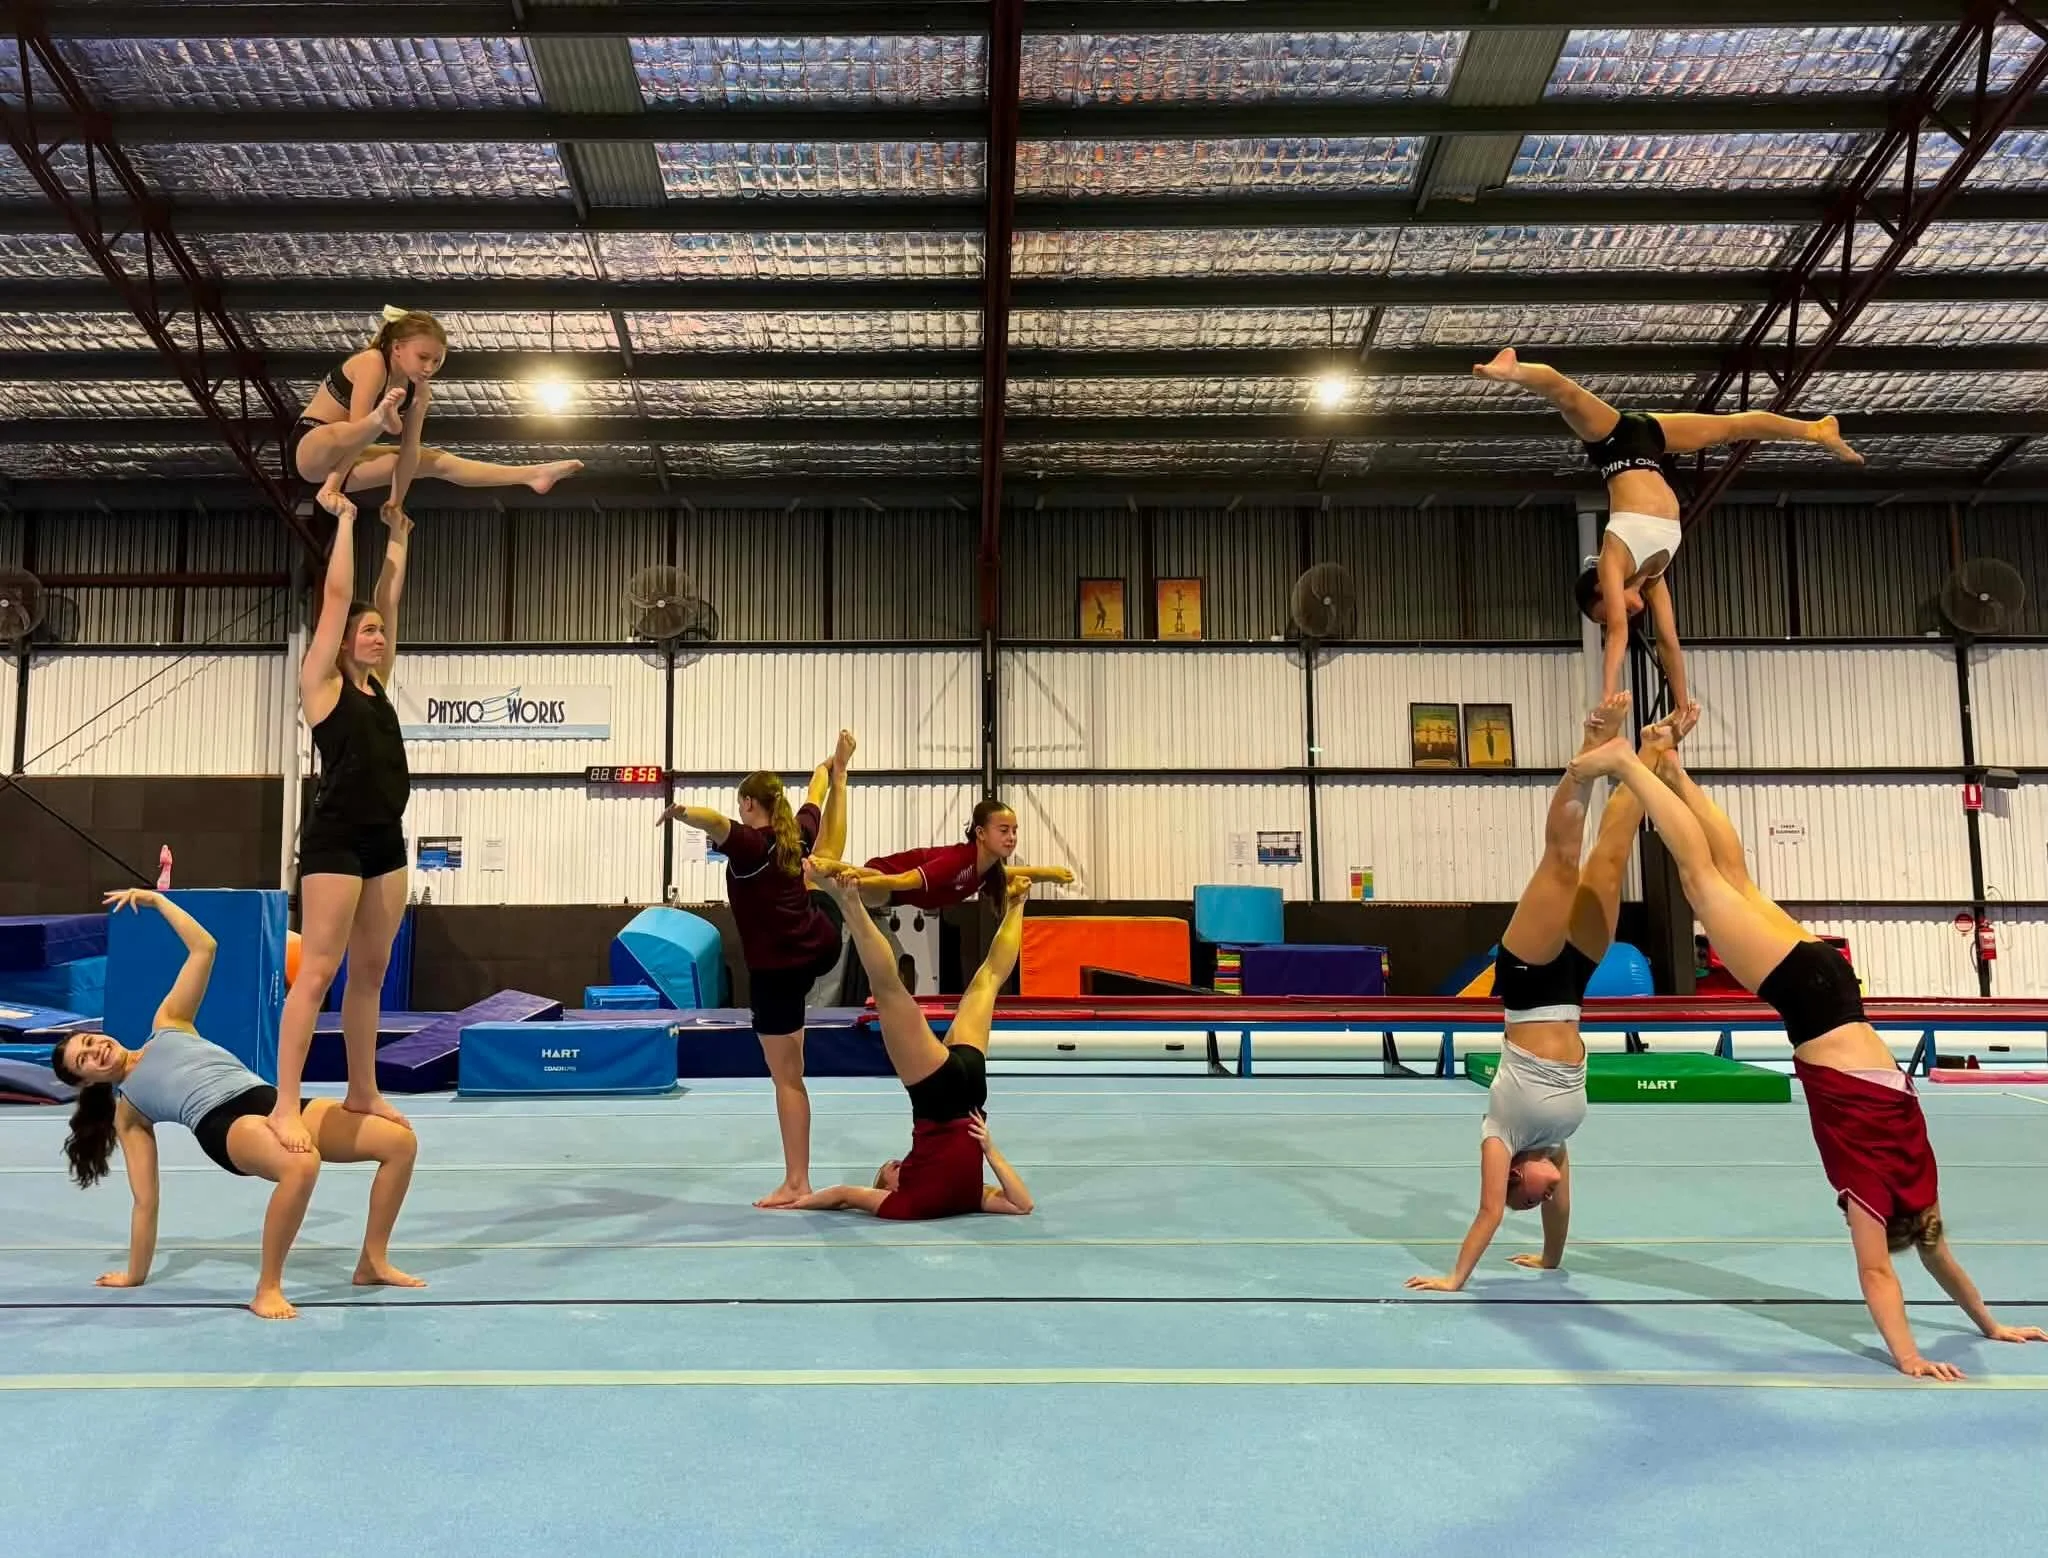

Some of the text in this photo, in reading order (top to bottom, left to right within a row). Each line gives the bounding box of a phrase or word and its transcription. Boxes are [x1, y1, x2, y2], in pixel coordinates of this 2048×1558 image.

[427, 697, 565, 724] PHYSIO WORKS
[541, 1048, 581, 1059] HART
[1637, 1080, 1678, 1090] HART
